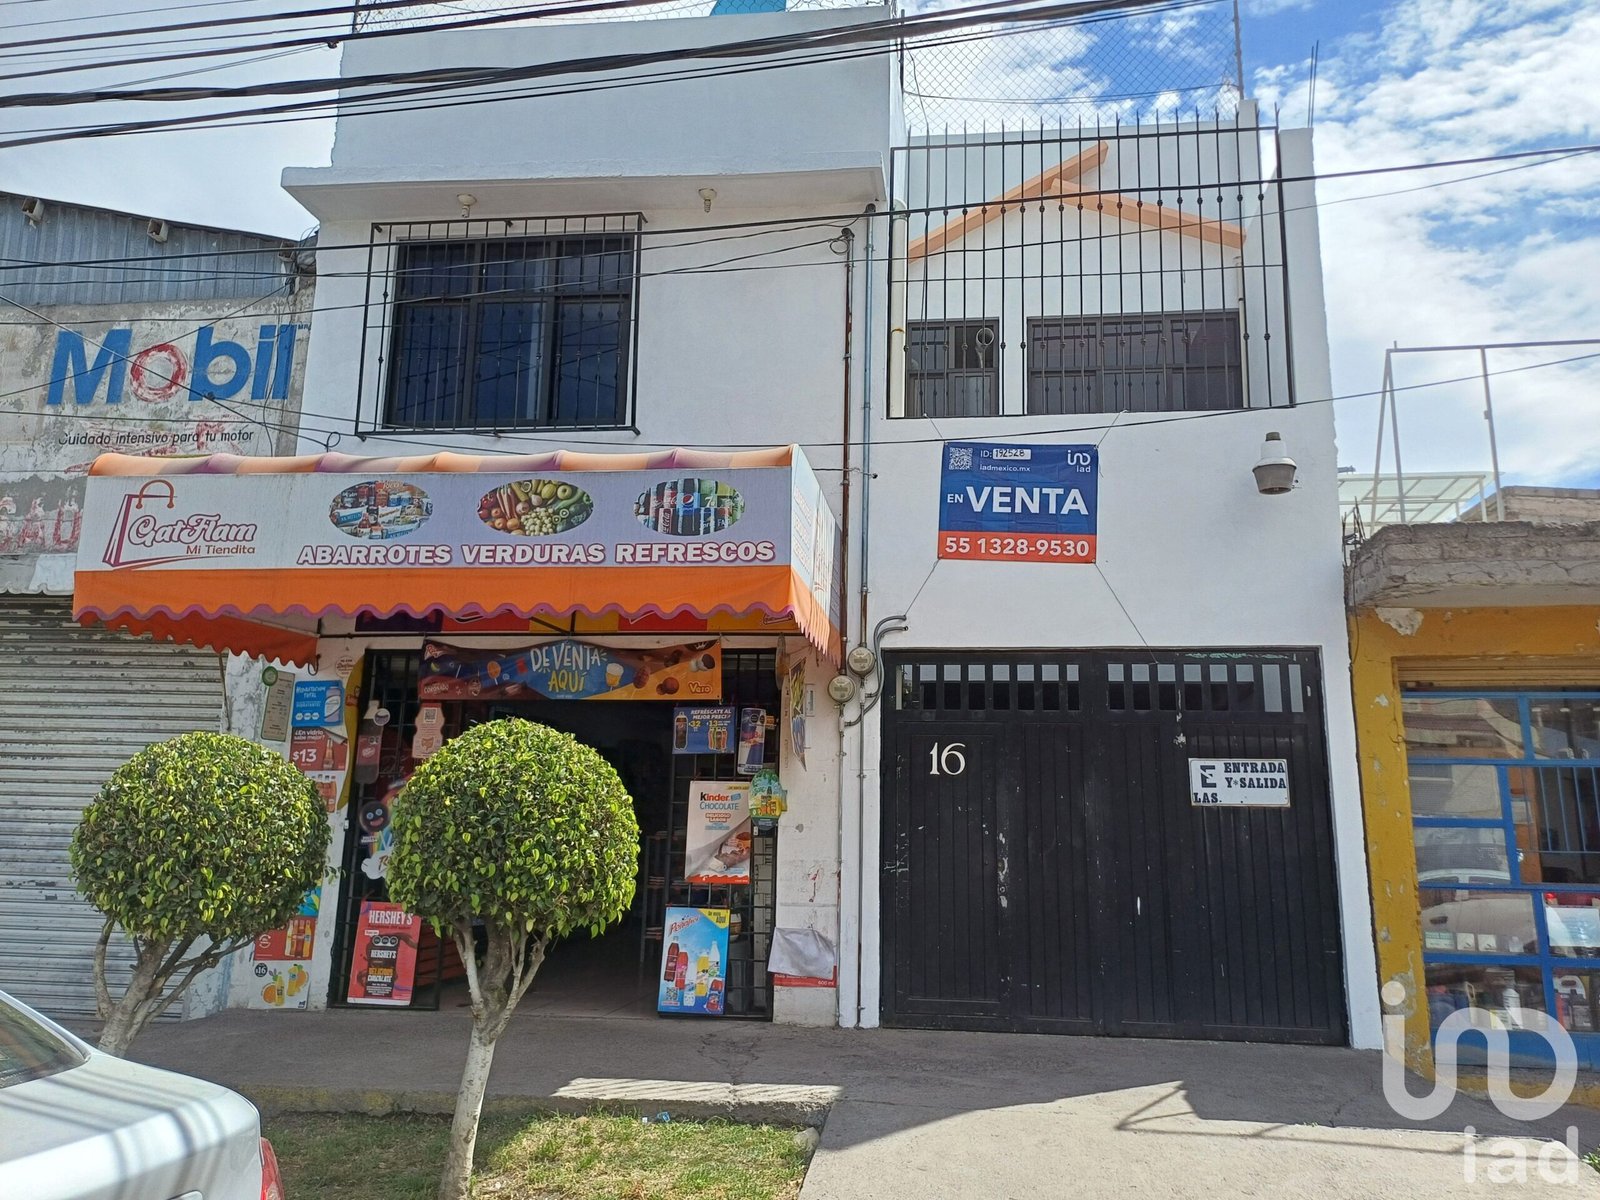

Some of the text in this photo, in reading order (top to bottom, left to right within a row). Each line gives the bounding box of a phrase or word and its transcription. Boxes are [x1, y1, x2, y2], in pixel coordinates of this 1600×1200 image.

[46, 324, 298, 406] Mobil
[59, 429, 254, 447] Cuidado intensivo para tu motor
[979, 463, 1031, 473] iadmexico.mx
[1076, 465, 1091, 473] iad
[947, 486, 1089, 516] EN VENTA
[186, 544, 256, 555] Mi Tiendita
[296, 541, 775, 567] ABARROTES VERDURAS REFRESCOS
[945, 537, 1090, 557] 55 1328-9530
[530, 643, 601, 672] DE VENTA
[548, 669, 588, 693] AQUÍ
[292, 748, 317, 763] $13
[929, 742, 967, 775] 16
[1223, 762, 1285, 774] ENTRADA
